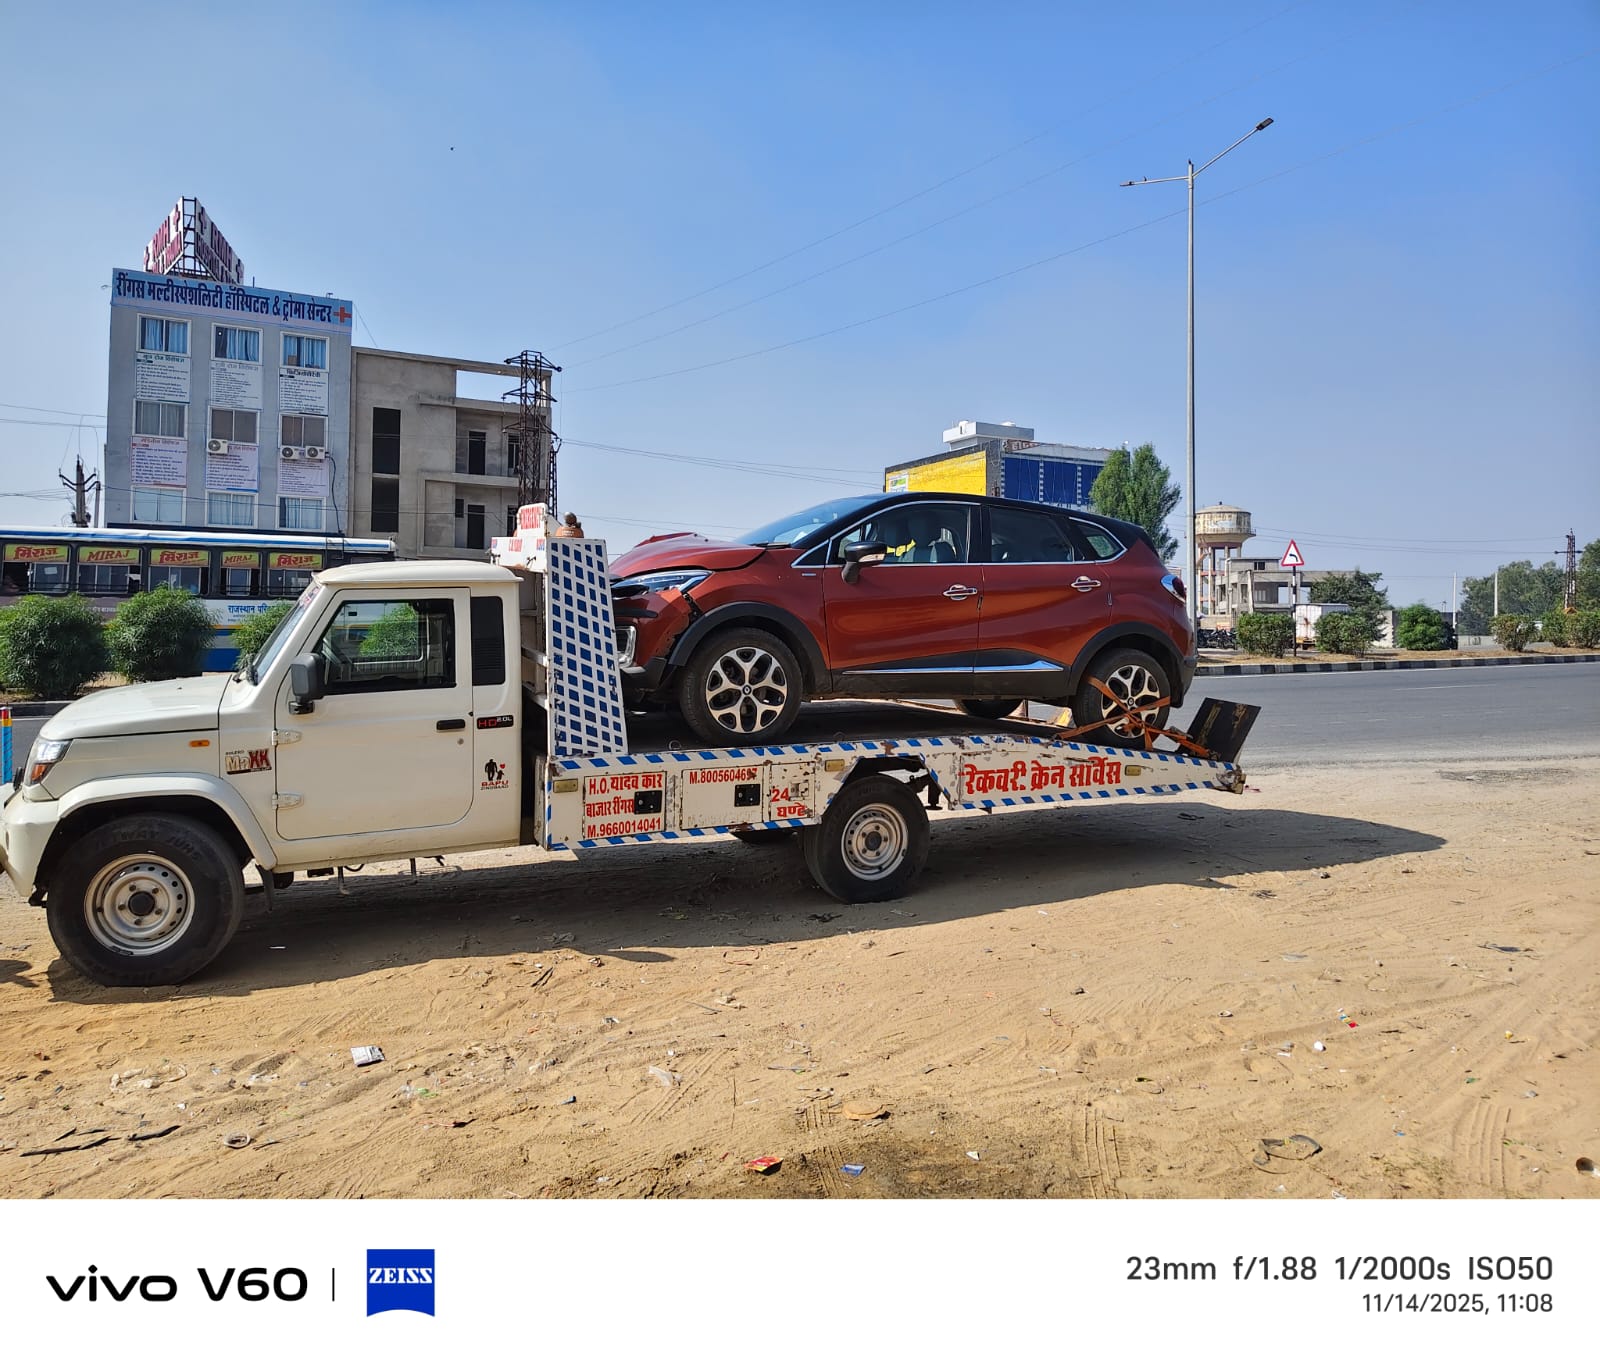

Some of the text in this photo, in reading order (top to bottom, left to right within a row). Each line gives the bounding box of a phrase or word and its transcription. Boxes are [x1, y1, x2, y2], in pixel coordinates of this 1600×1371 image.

[116, 272, 332, 323] रींगस मल्टीस्पेशलिटी हॉस्पिटल & ट्रोमा सेन्टर
[87, 550, 130, 562] MIRAJ
[224, 554, 252, 564] MIRAJ
[228, 605, 255, 614] राजस्थान
[478, 719, 497, 727] HD
[1031, 760, 1065, 792] क्रेन
[589, 774, 662, 795] H.O. यादव कार
[771, 788, 789, 803] 24
[586, 796, 635, 818] बाजार रींगस
[777, 802, 807, 817] घण्टे
[587, 817, 661, 838] M.9660014041
